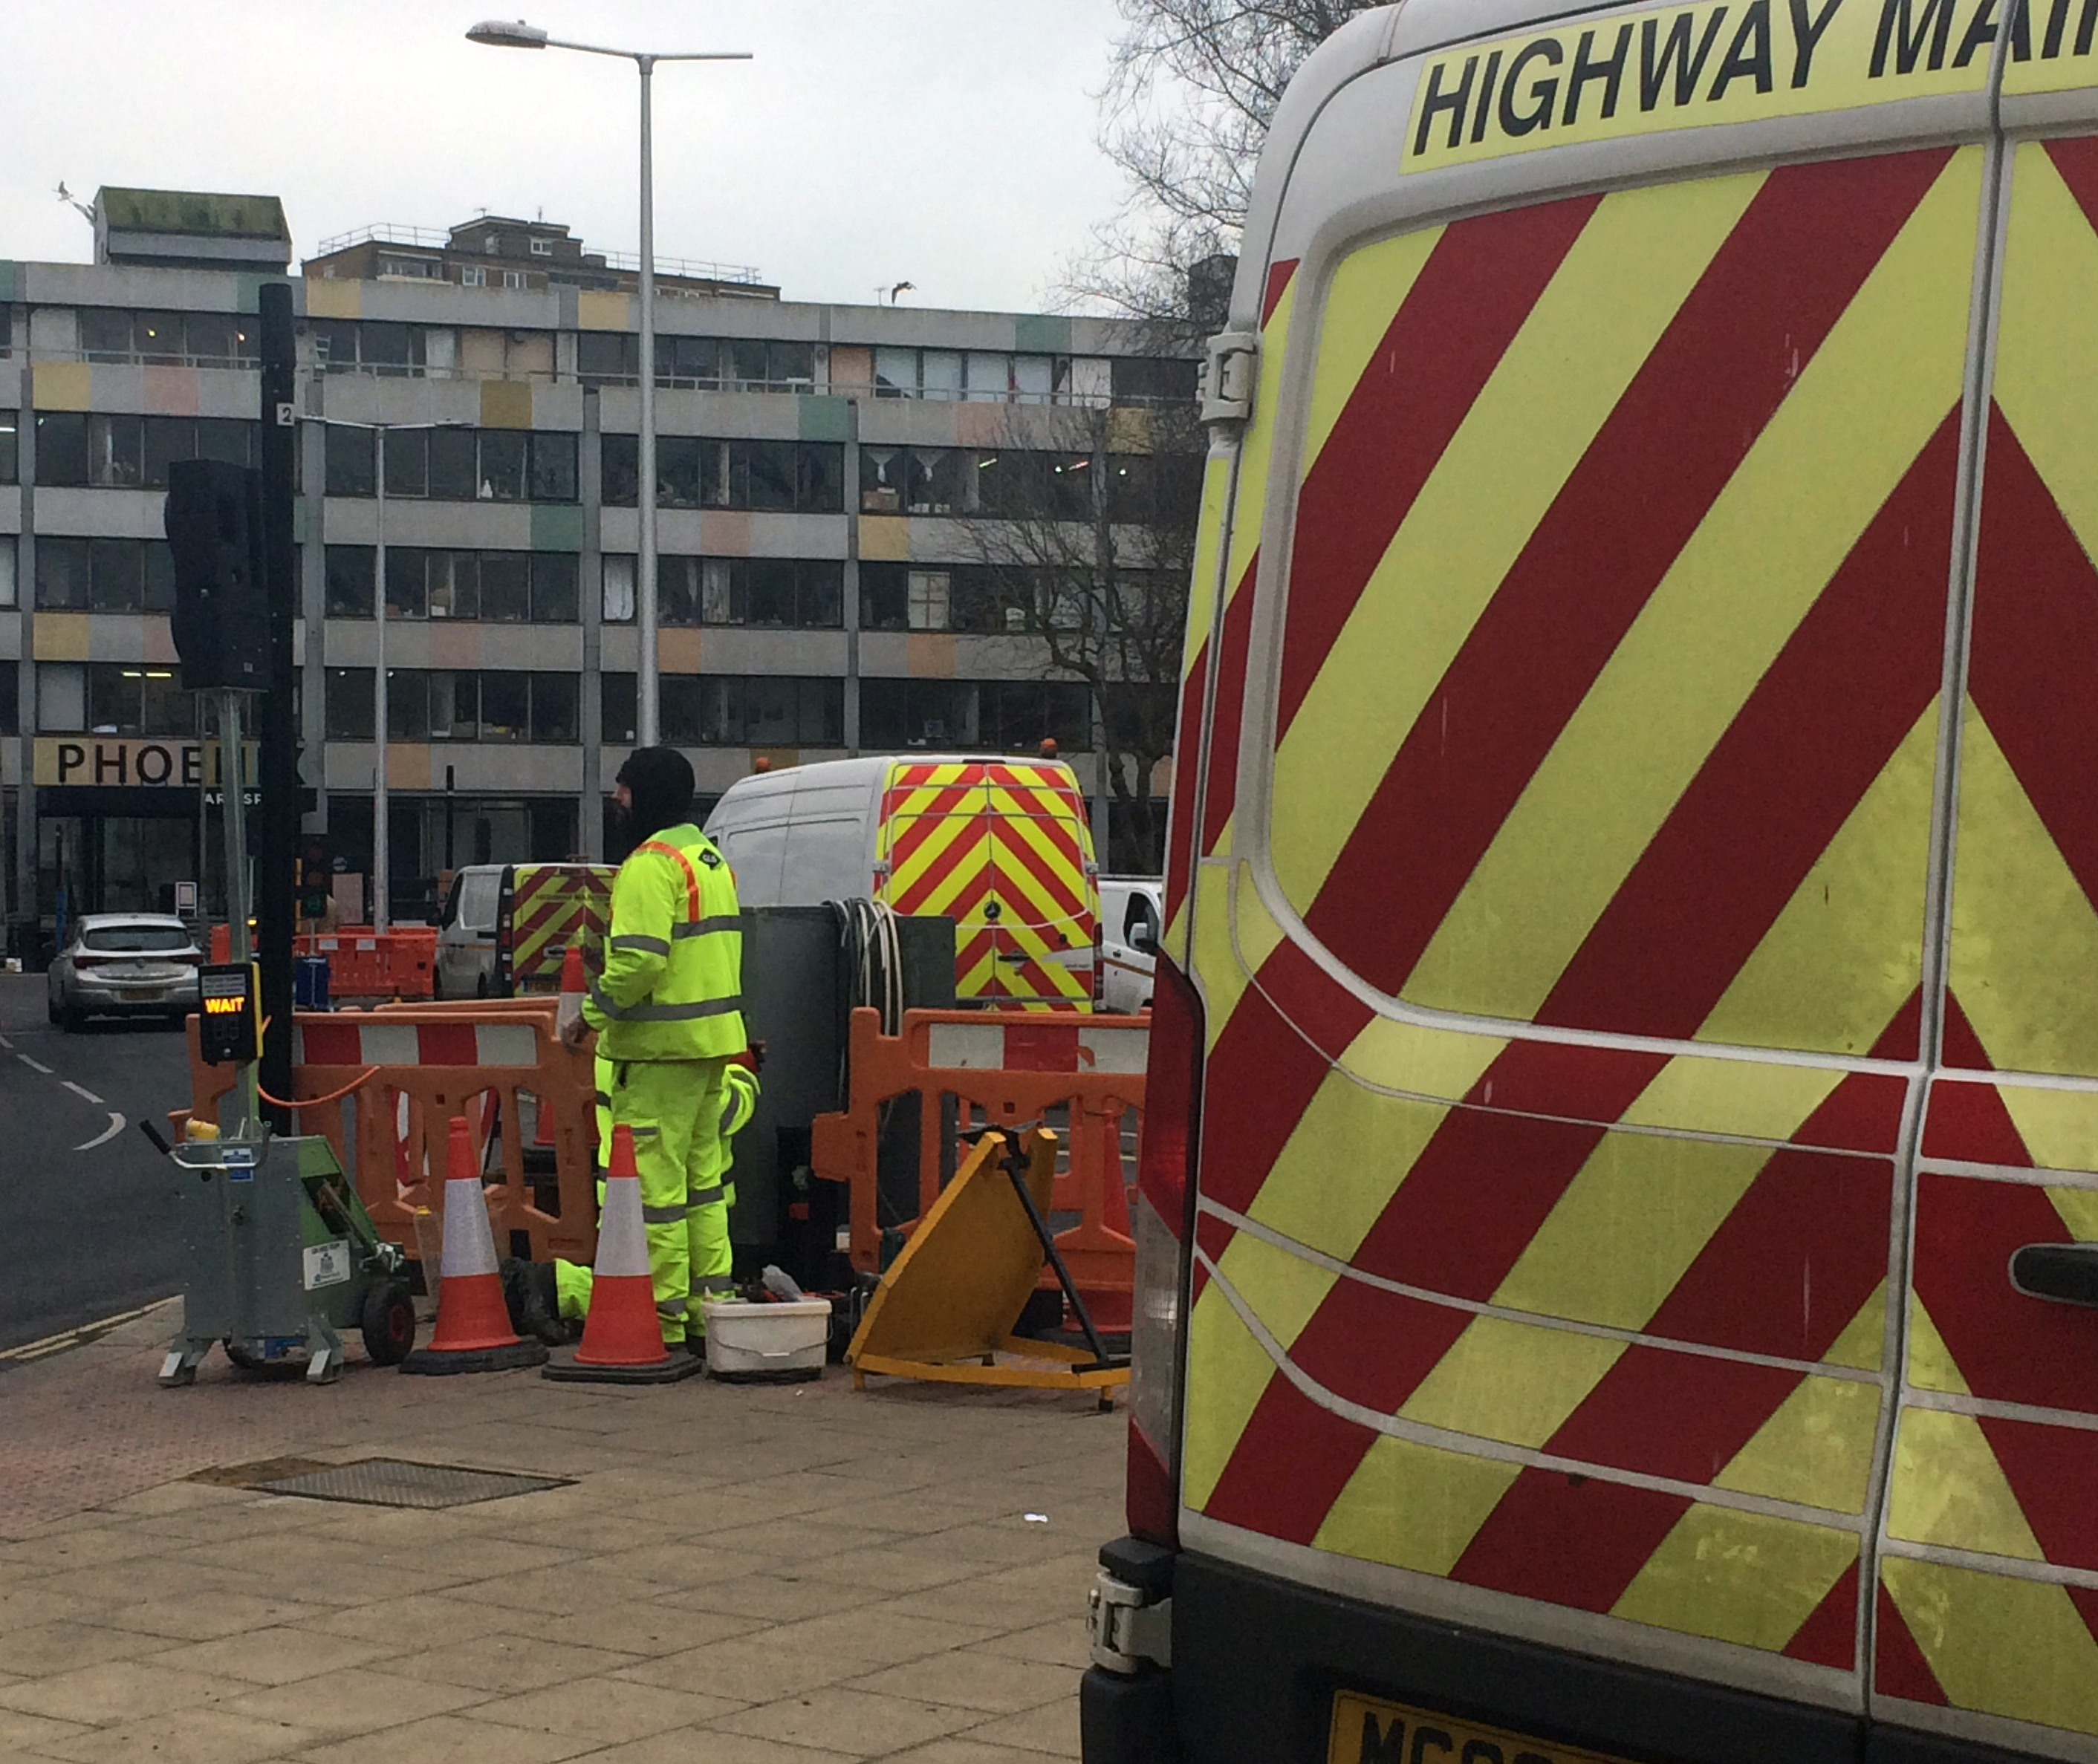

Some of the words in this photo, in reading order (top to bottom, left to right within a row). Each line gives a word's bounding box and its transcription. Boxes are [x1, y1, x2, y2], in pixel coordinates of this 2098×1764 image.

[1413, 0, 1842, 156] HIGHWAY
[1868, 0, 2098, 79] MAI
[282, 407, 292, 423] 2
[205, 997, 245, 1013] WAIT
